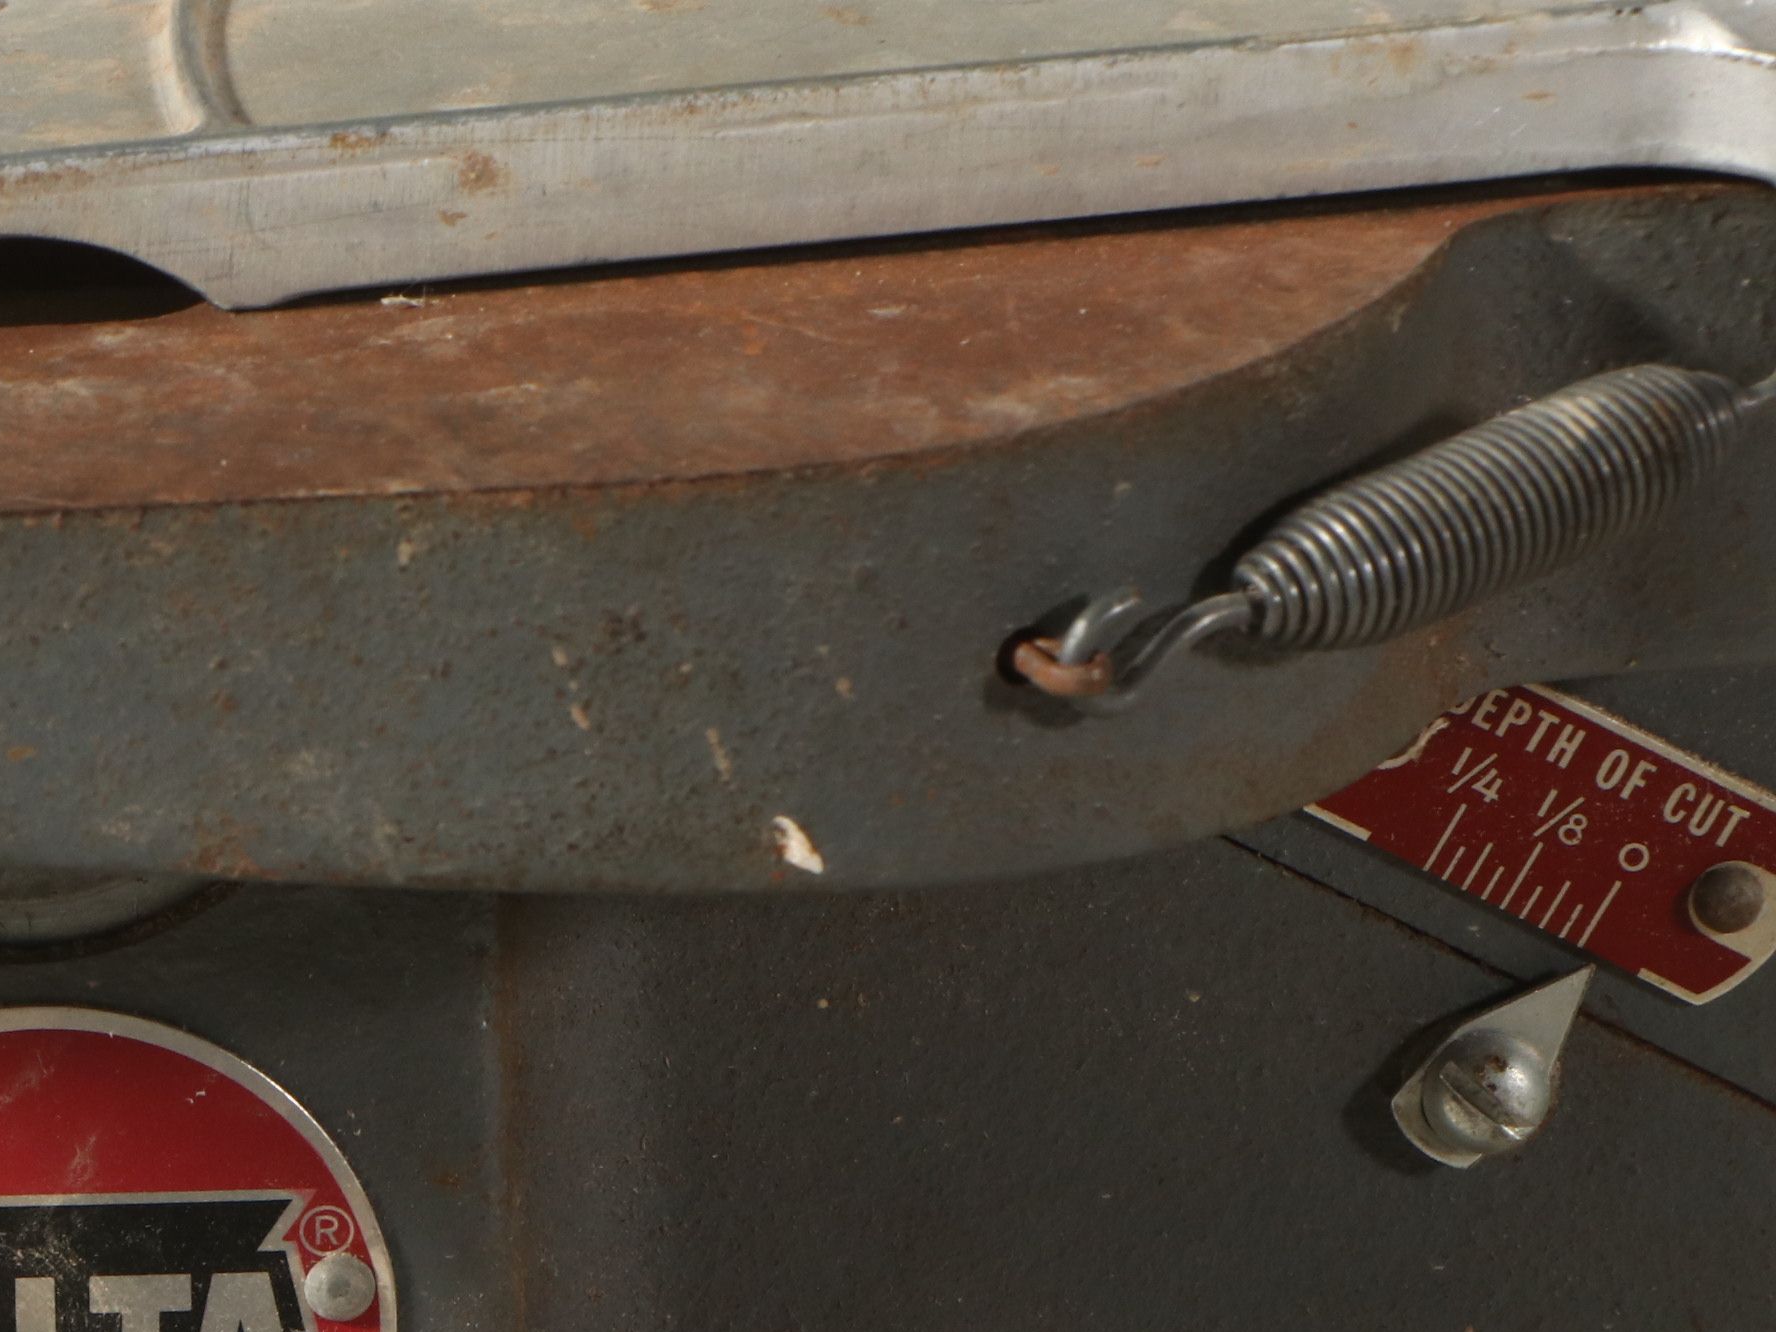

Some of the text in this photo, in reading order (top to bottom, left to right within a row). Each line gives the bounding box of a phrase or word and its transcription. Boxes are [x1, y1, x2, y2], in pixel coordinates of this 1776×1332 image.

[1447, 747, 1504, 803] 1/4
[1532, 788, 1588, 846] 1/8
[1595, 748, 1658, 800] OF
[1662, 782, 1751, 848] CUT
